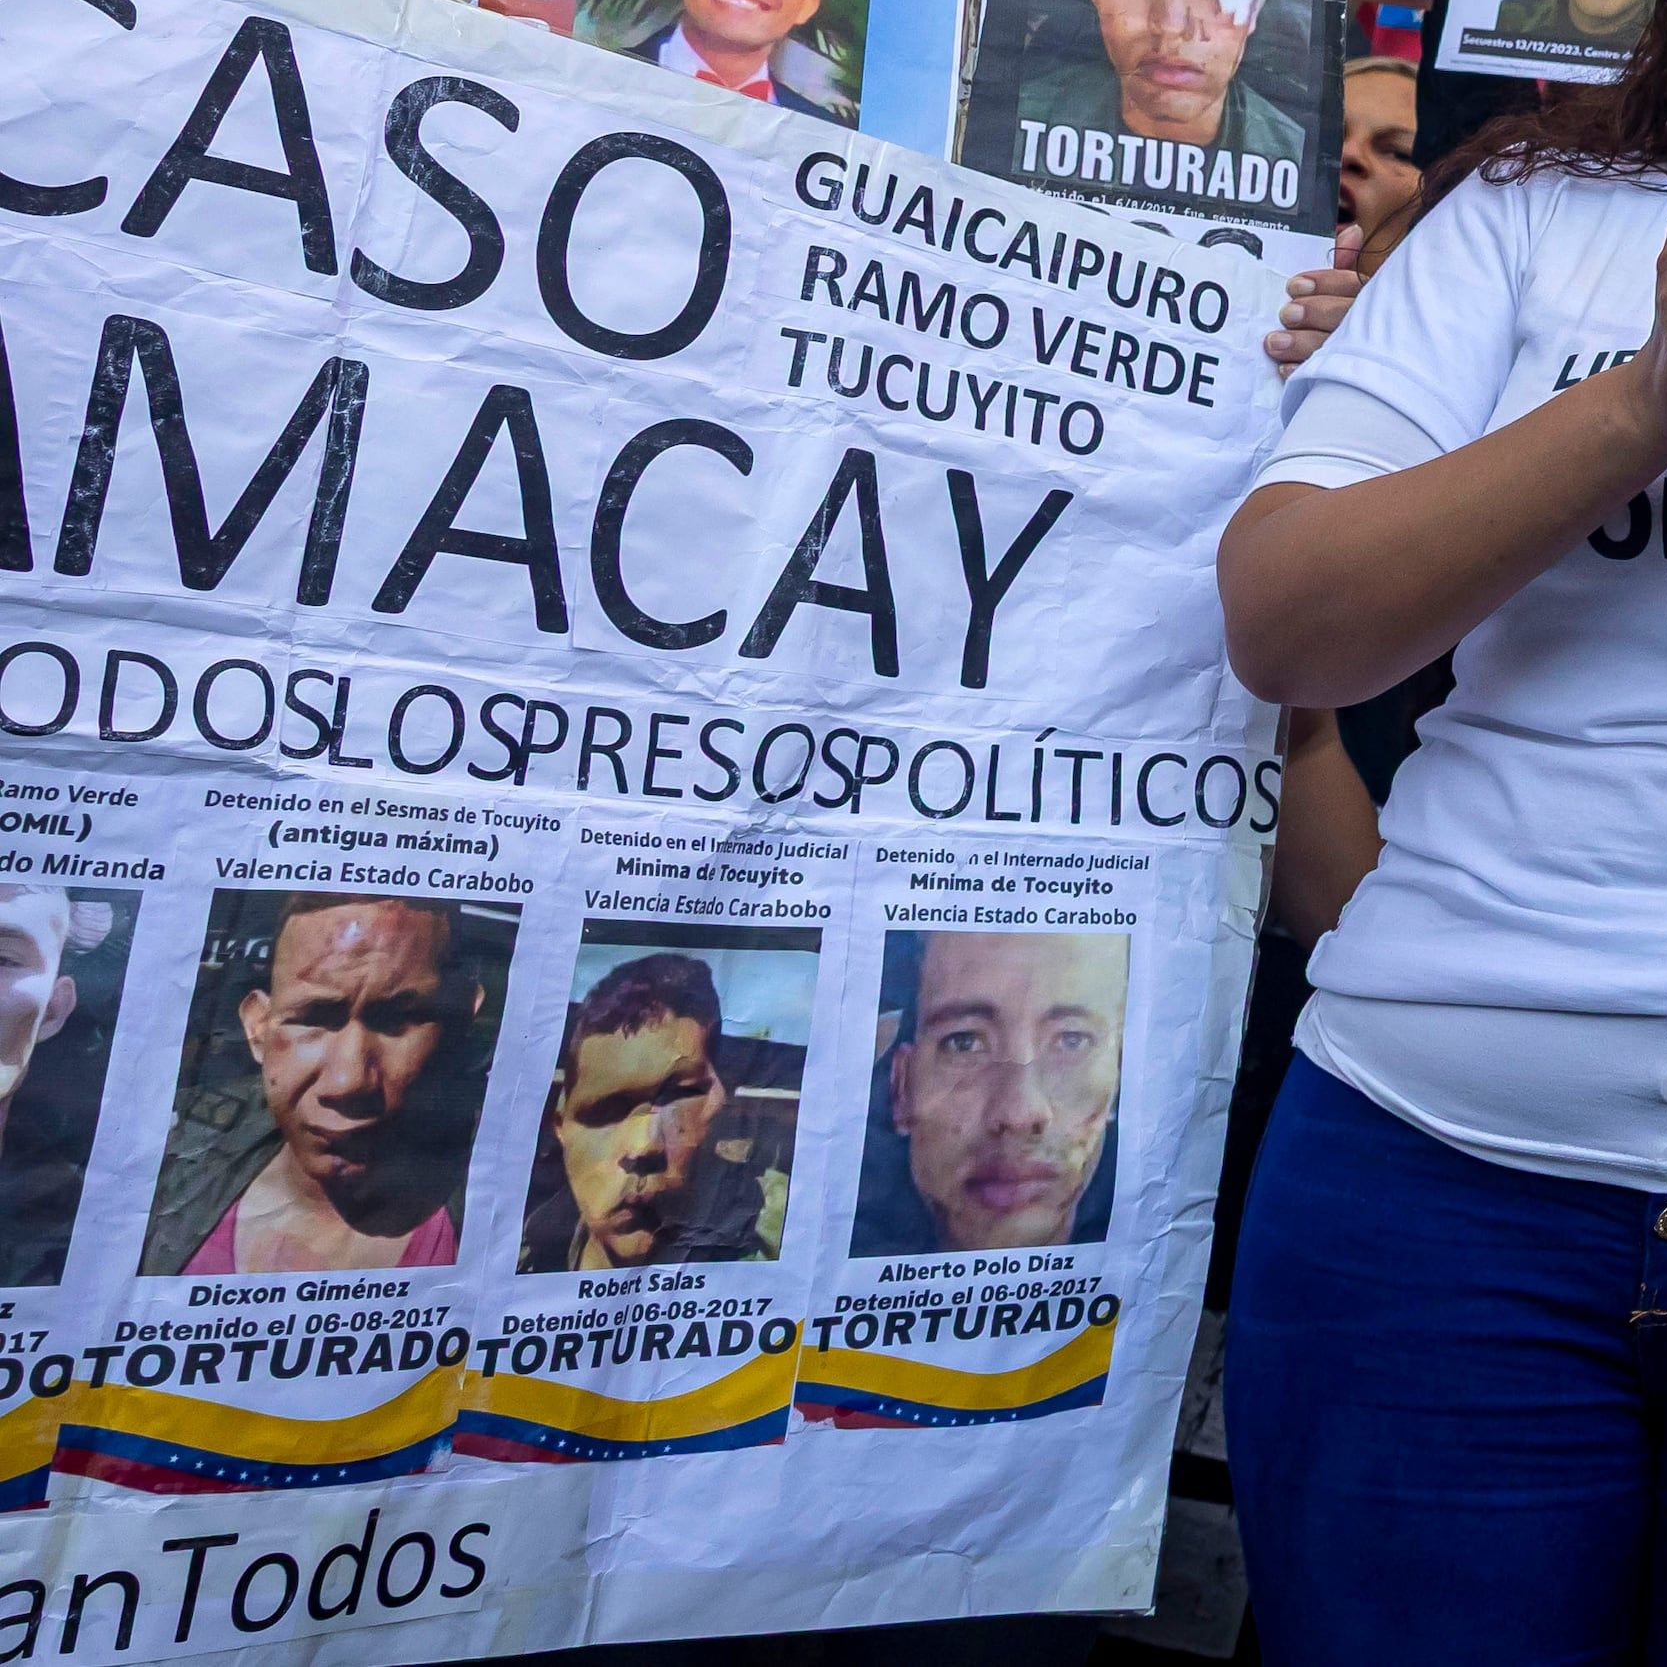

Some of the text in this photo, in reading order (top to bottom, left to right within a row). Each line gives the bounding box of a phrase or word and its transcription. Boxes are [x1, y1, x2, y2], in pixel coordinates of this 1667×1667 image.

[1018, 119, 1301, 211] TORTURADO
[794, 151, 1230, 335] GUAICAIPURO
[799, 244, 1220, 409] RAMO VERDE
[779, 327, 1105, 457] TUCUYITO
[0, 314, 1076, 690] MACAY
[69, 784, 139, 808] Verde
[204, 789, 562, 833] Detenido Sesmas Tocuyito
[268, 819, 500, 861] (antigua máxima)
[580, 827, 849, 862] Detenido Internado Judicial
[42, 852, 166, 881] Miranda
[215, 856, 535, 895] Valencia Estado Carabobo
[718, 864, 804, 889] Tocuyito
[875, 846, 1150, 874] Detenido Internado Judicial
[910, 871, 1114, 901] Mínima Tocuyito
[584, 890, 832, 922] Valencia Estado Carabobo
[883, 902, 1138, 930] Valencia Estado Carabobo
[577, 1271, 706, 1300] Robert Salas
[878, 1252, 1076, 1284] Alberto Polo Díaz
[188, 1278, 410, 1307] Dicxon Giménez
[833, 1276, 1102, 1314] Detenido 06-08-2017
[115, 1306, 452, 1343] Detenido 06-08-2017
[502, 1297, 773, 1336] Detenido 06-08-2017
[811, 1293, 1121, 1352] TORTURADO
[82, 1326, 471, 1389] TORTURADO
[475, 1316, 797, 1378] TORTURADO
